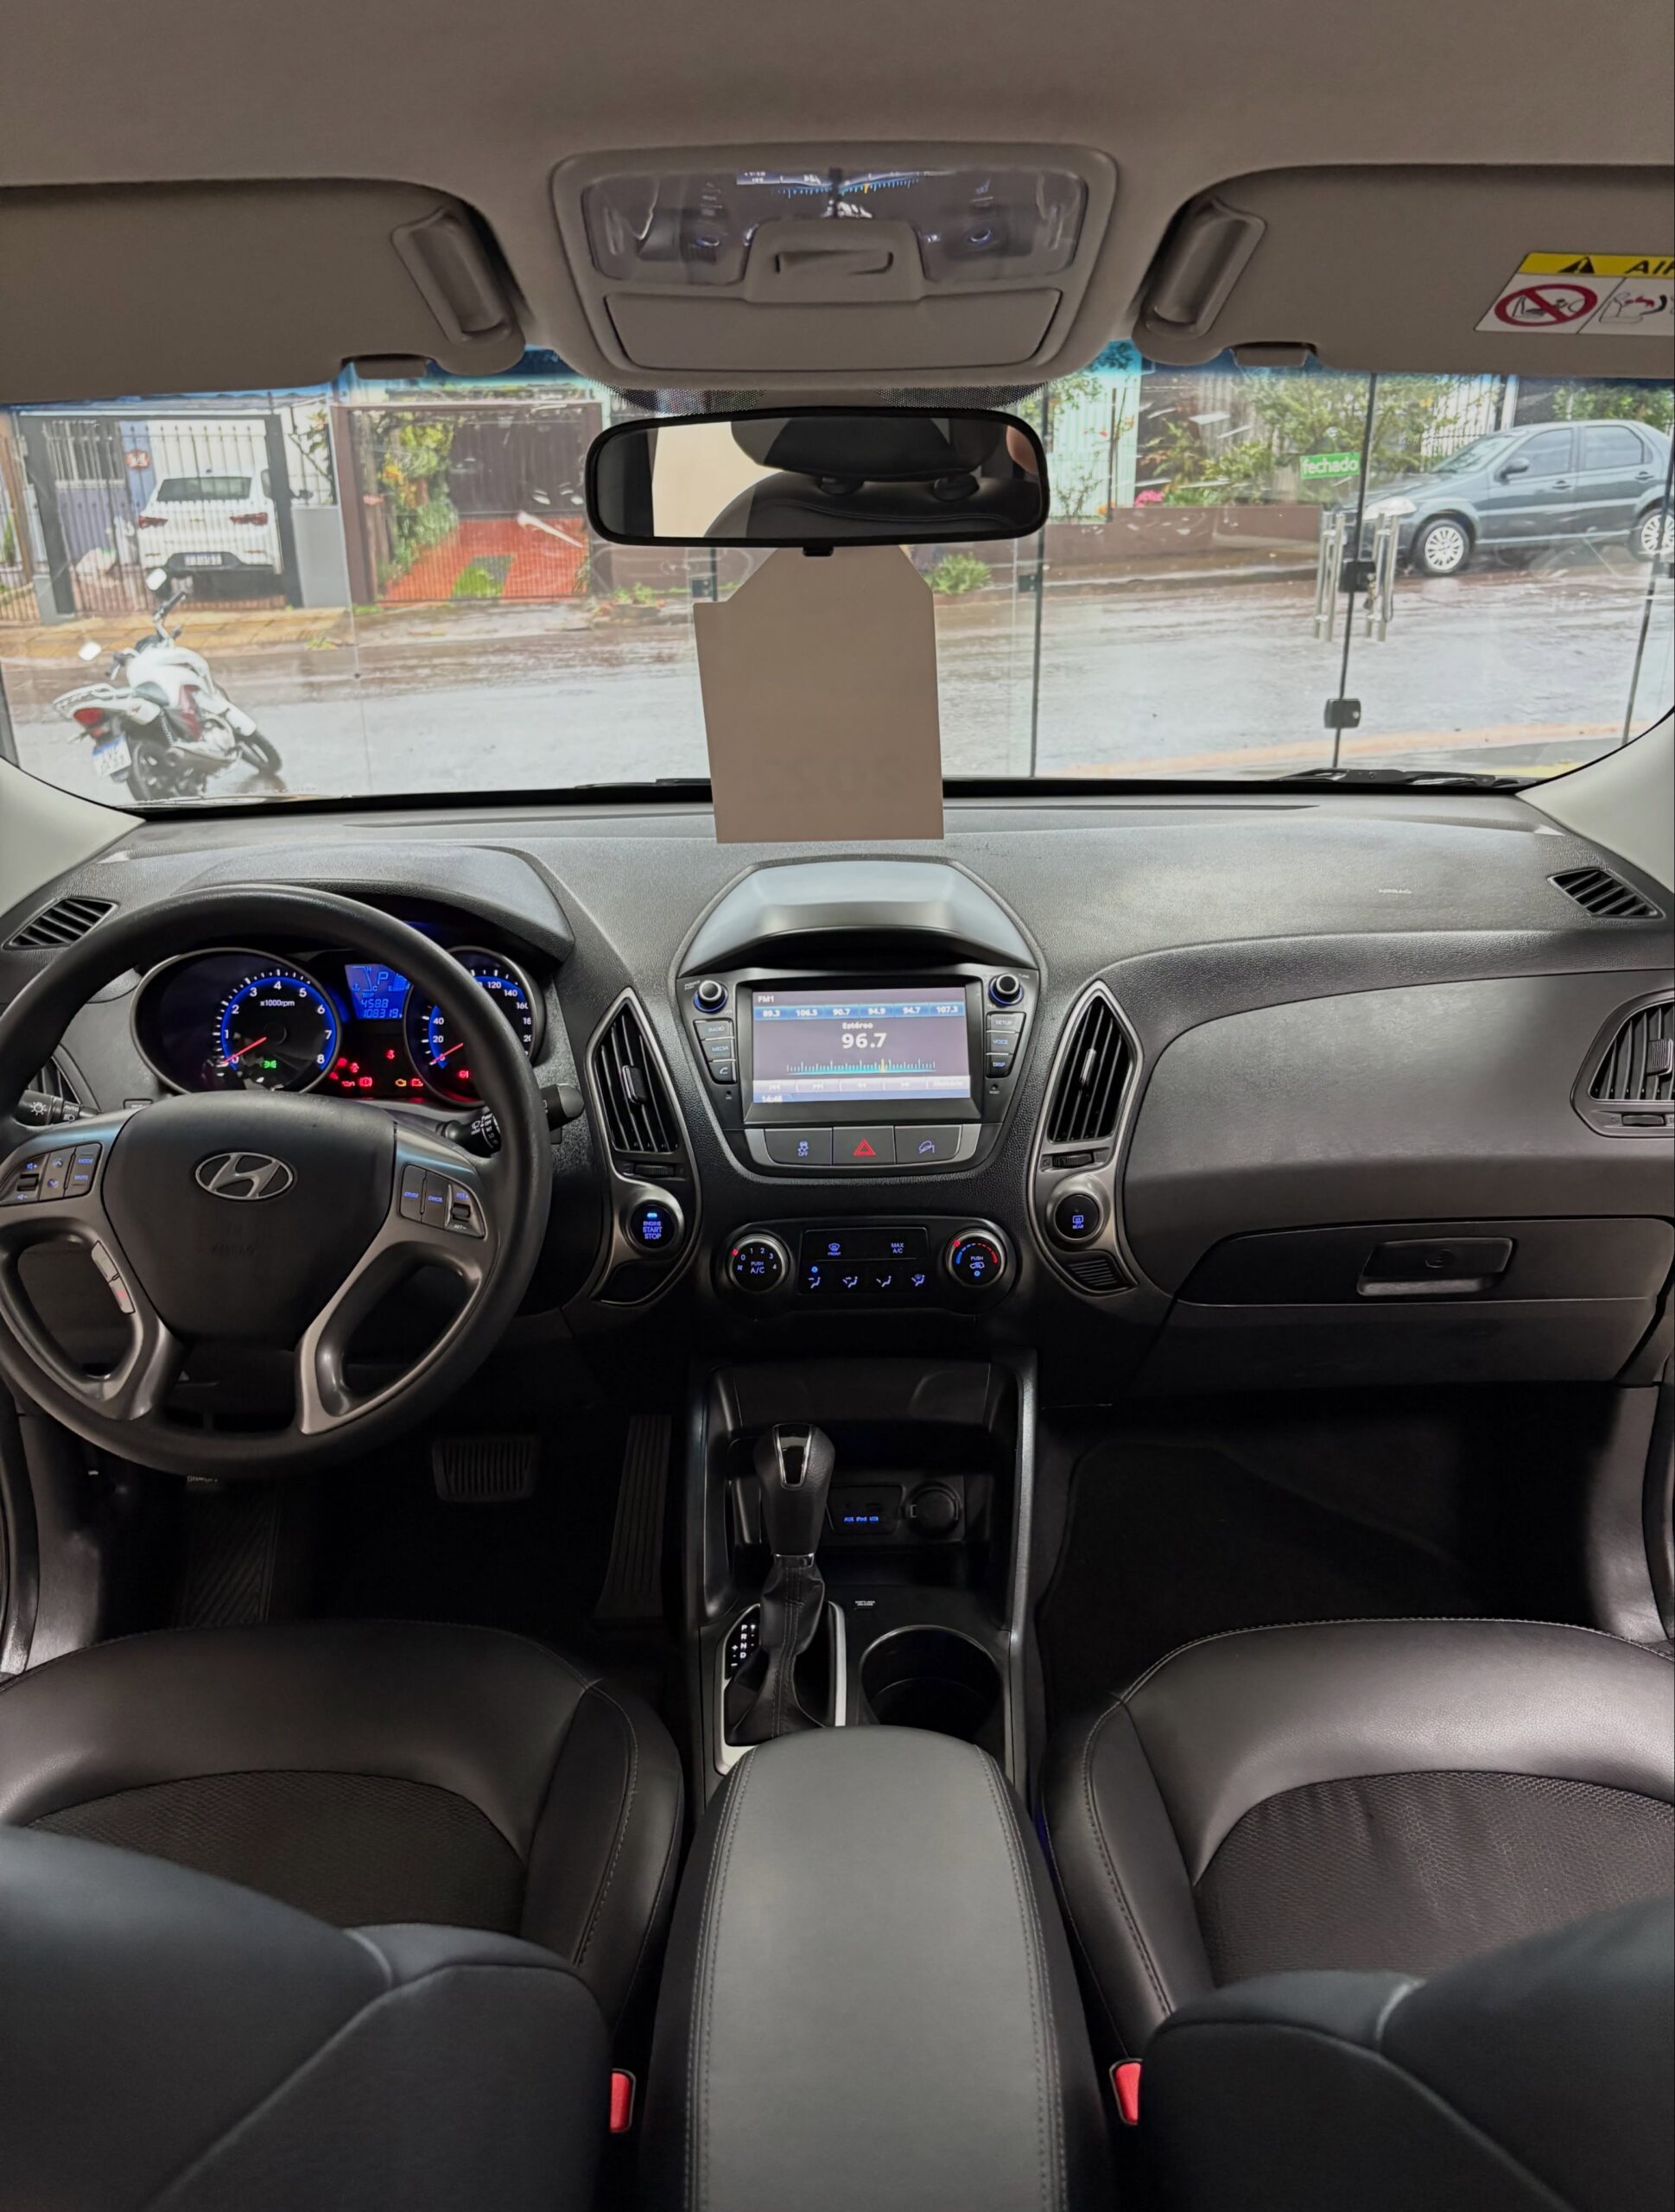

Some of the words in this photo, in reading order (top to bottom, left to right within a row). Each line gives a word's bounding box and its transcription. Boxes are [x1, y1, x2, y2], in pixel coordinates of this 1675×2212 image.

[1302, 456, 1357, 474] fechado
[273, 981, 282, 990] 4
[249, 988, 257, 997] 3
[298, 988, 308, 997] 5
[231, 1005, 240, 1014] 2
[316, 1005, 326, 1014] 6
[224, 1029, 230, 1039] 1
[325, 1030, 333, 1039] 7
[842, 1033, 887, 1049] 96.7
[316, 1054, 325, 1064] 8
